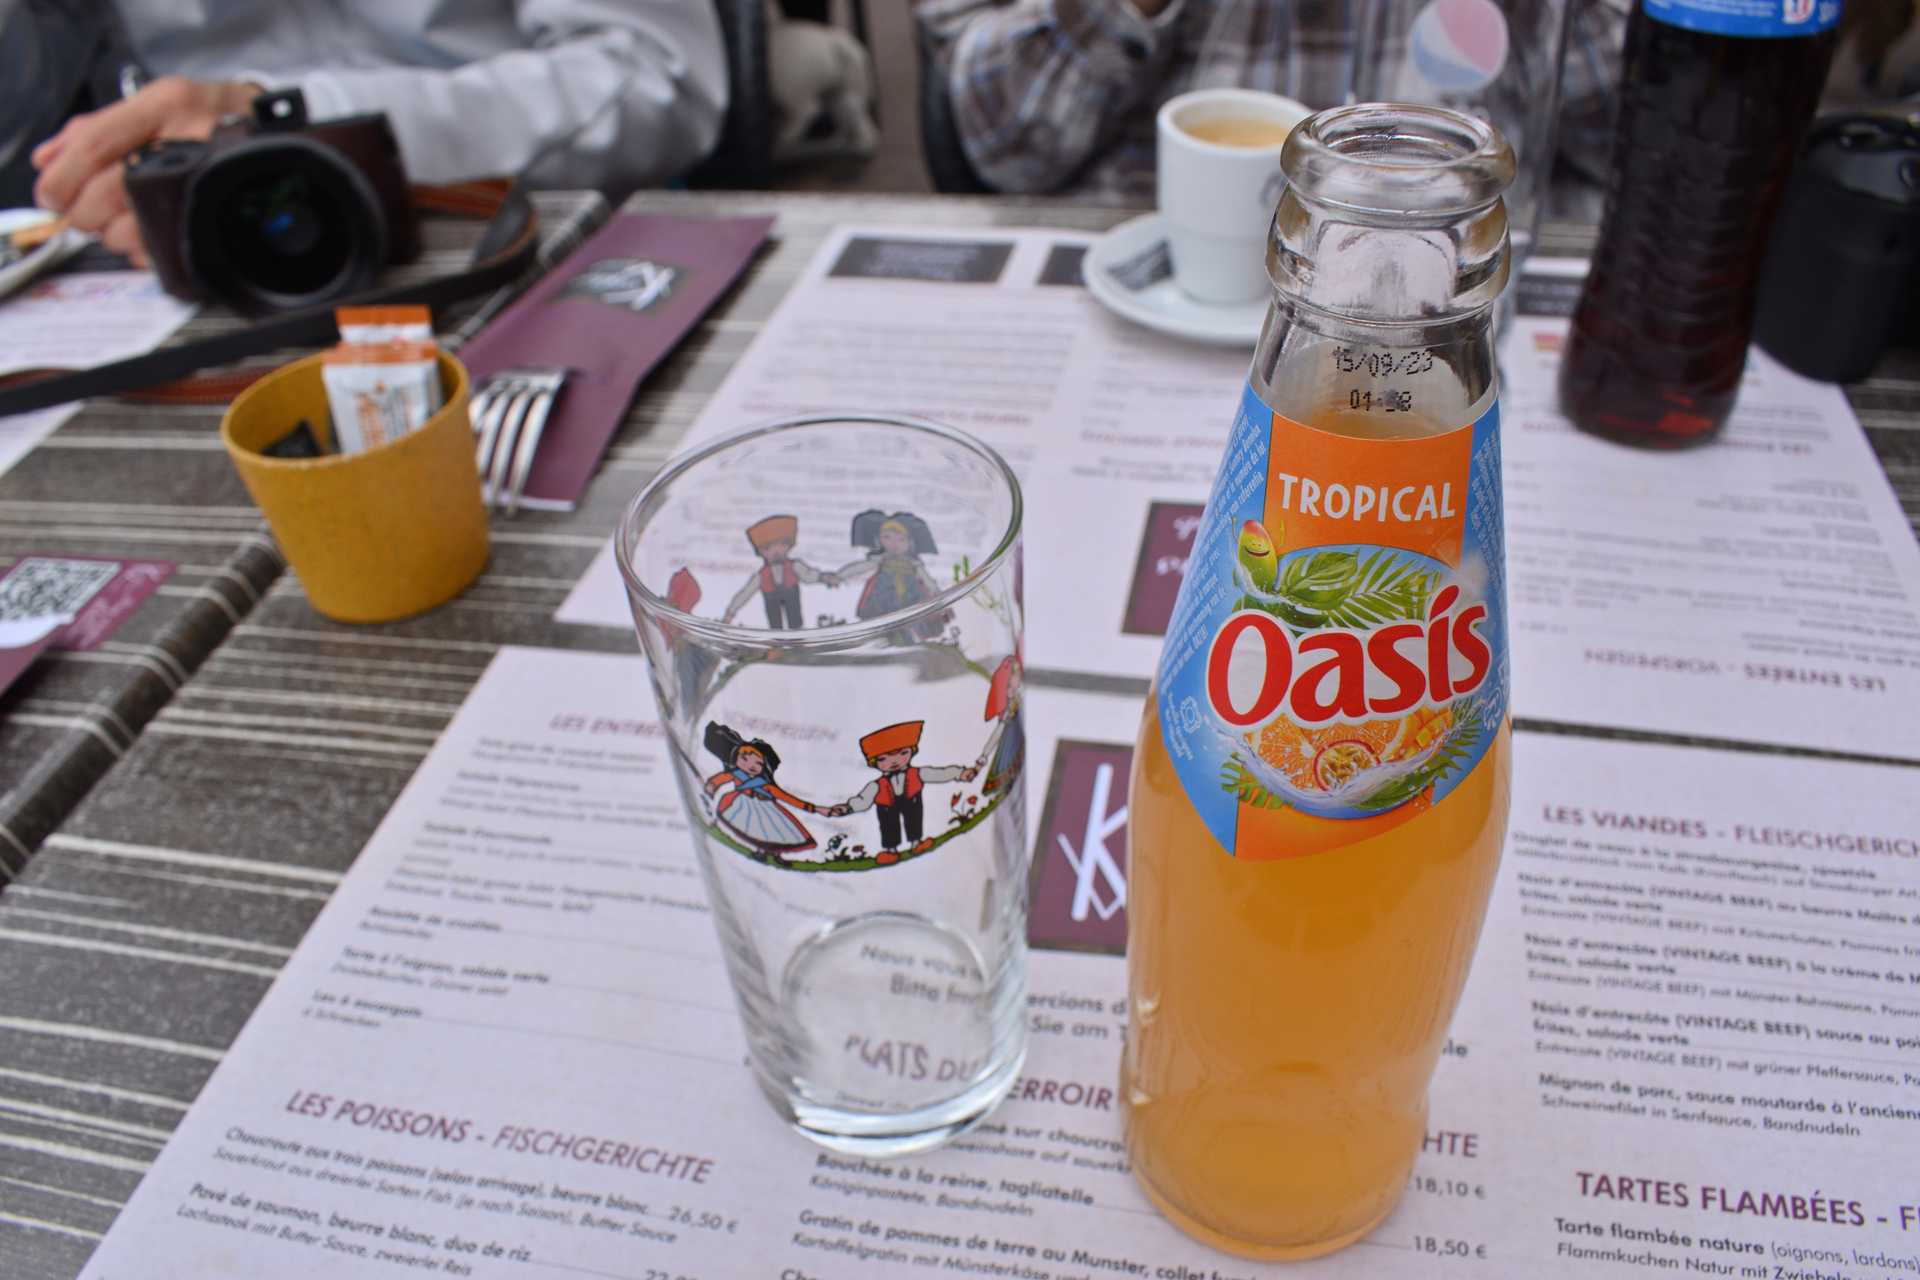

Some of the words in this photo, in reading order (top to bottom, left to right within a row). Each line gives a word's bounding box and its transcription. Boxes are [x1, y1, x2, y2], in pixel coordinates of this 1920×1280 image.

[1333, 346, 1433, 376] 15/09/23
[1278, 472, 1455, 521] TROPICAL
[1206, 584, 1493, 728] Oasis
[1543, 804, 1584, 826] LES
[1591, 809, 1707, 839] VIANDES
[1031, 1016, 1064, 1034] Sie
[1071, 1024, 1108, 1039] am
[845, 1034, 930, 1080] PLATS
[1004, 1077, 1114, 1111] ERROIR
[1539, 1072, 1604, 1091] Mignon
[1610, 1080, 1632, 1094] de
[1741, 1093, 1827, 1113] moutarde
[285, 1090, 334, 1118] LES
[333, 1100, 472, 1143] POISSONS
[492, 1125, 715, 1184] FISCHGERICHTE
[1013, 1126, 1041, 1141] sur
[1048, 1129, 1127, 1154] choucro
[1763, 1116, 1861, 1136] Bandnudeln
[816, 1153, 894, 1181] Bouchée
[899, 1164, 911, 1181] à
[916, 1167, 934, 1185] la
[940, 1173, 993, 1193] reine,
[1000, 1179, 1095, 1205] tagliatelle
[1415, 1176, 1469, 1198] 18,10
[1474, 1183, 1487, 1200] €
[1576, 1171, 1690, 1208] TARTES
[1700, 1186, 1865, 1227] FLAMBÉES
[189, 1183, 227, 1204] Pavé
[229, 1192, 251, 1208] de
[253, 1199, 323, 1226] saumon,
[327, 1211, 384, 1236] beurre
[388, 1224, 438, 1249] blanc,
[443, 1235, 478, 1254] duo
[481, 1242, 504, 1259] de
[507, 1246, 530, 1263] riz
[550, 1181, 601, 1207] beurre
[668, 1206, 722, 1231] 26,50
[798, 1208, 853, 1234] Gratin
[858, 1219, 880, 1237] de
[884, 1225, 960, 1250] pommes
[966, 1233, 989, 1251] de
[994, 1239, 1038, 1260] terre
[1042, 1248, 1067, 1263] au
[1071, 1249, 1149, 1277] Munster,
[1413, 1235, 1469, 1258] 18,50
[1475, 1244, 1487, 1260] €
[1555, 1217, 1604, 1237] Tarte
[1610, 1221, 1693, 1247] flambée
[1699, 1235, 1765, 1255] nature
[1771, 1241, 1849, 1266] (oignons,
[1557, 1242, 1680, 1271] Flammkuchen
[1685, 1257, 1734, 1277] Natur
[1741, 1266, 1769, 1280] mit
